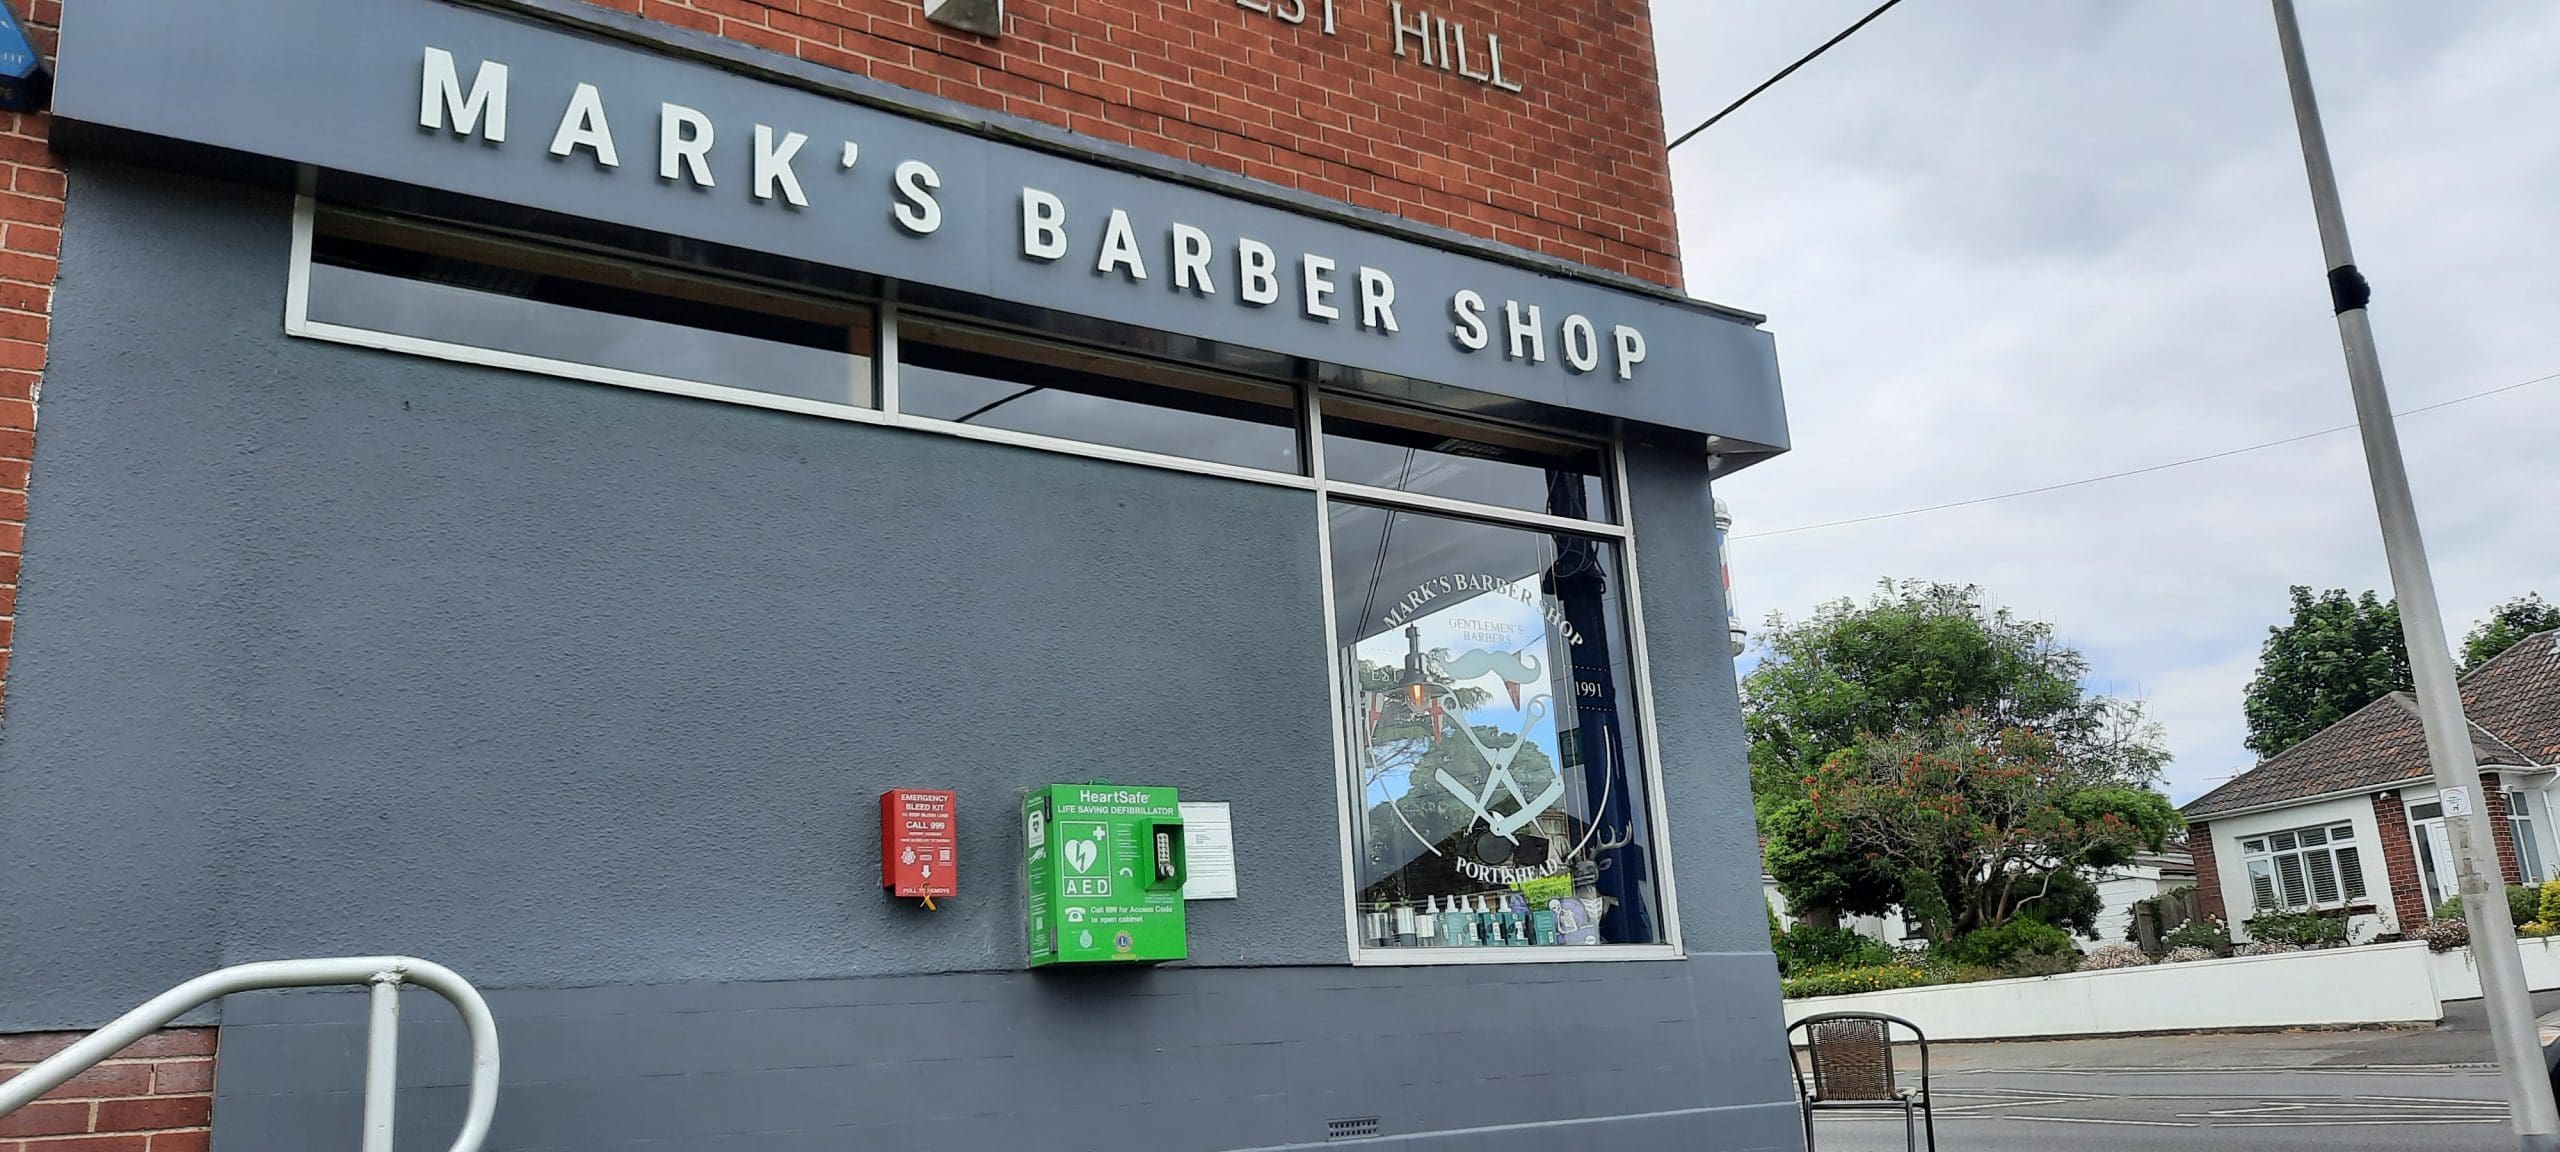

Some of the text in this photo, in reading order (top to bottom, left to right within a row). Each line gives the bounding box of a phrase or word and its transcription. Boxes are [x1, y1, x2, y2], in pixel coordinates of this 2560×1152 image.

[1391, 1, 1523, 93] HILL
[419, 46, 1647, 381] MARK'S BARBER SHOP
[1383, 573, 1585, 648] MARK'S BARBER SHOP
[1463, 631, 1512, 645] BARBERS
[1575, 680, 1602, 698] 1991
[901, 794, 948, 802] EMERGENCY
[1080, 789, 1149, 804] HeartSafe
[905, 803, 931, 811] BLEED
[1057, 805, 1076, 813] LIFE
[1078, 805, 1109, 814] SAVING
[1110, 806, 1174, 816] DEFIBRILLATOR
[906, 821, 945, 829] CALL 999
[1455, 856, 1558, 885] PORTISHEAD
[1155, 905, 1173, 913] Code
[1099, 916, 1117, 924] open
